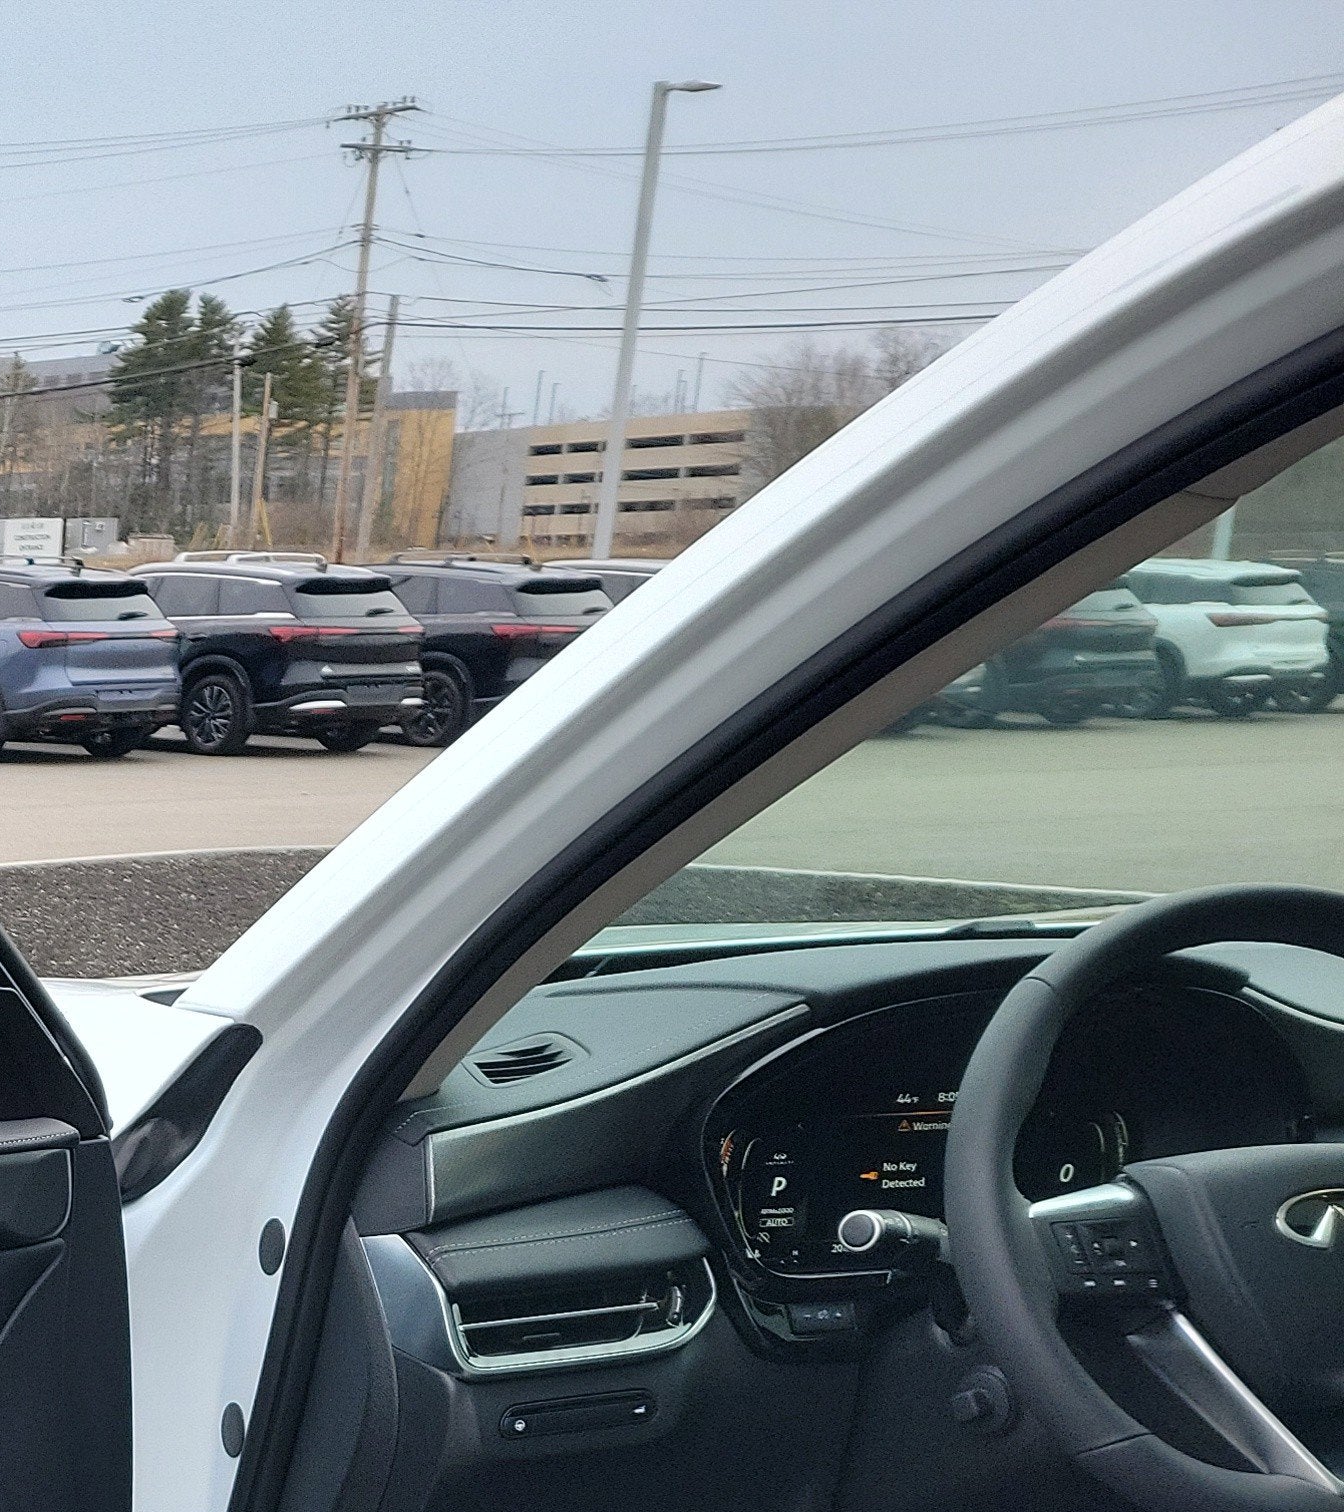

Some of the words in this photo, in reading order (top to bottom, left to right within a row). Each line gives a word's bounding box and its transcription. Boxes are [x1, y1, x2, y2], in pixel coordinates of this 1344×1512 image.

[882, 1162, 898, 1171] No
[899, 1161, 917, 1172] Key
[1059, 1163, 1075, 1183] 0
[770, 1176, 788, 1197] P
[881, 1177, 925, 1189] Detected
[765, 1217, 789, 1227] AUTO
